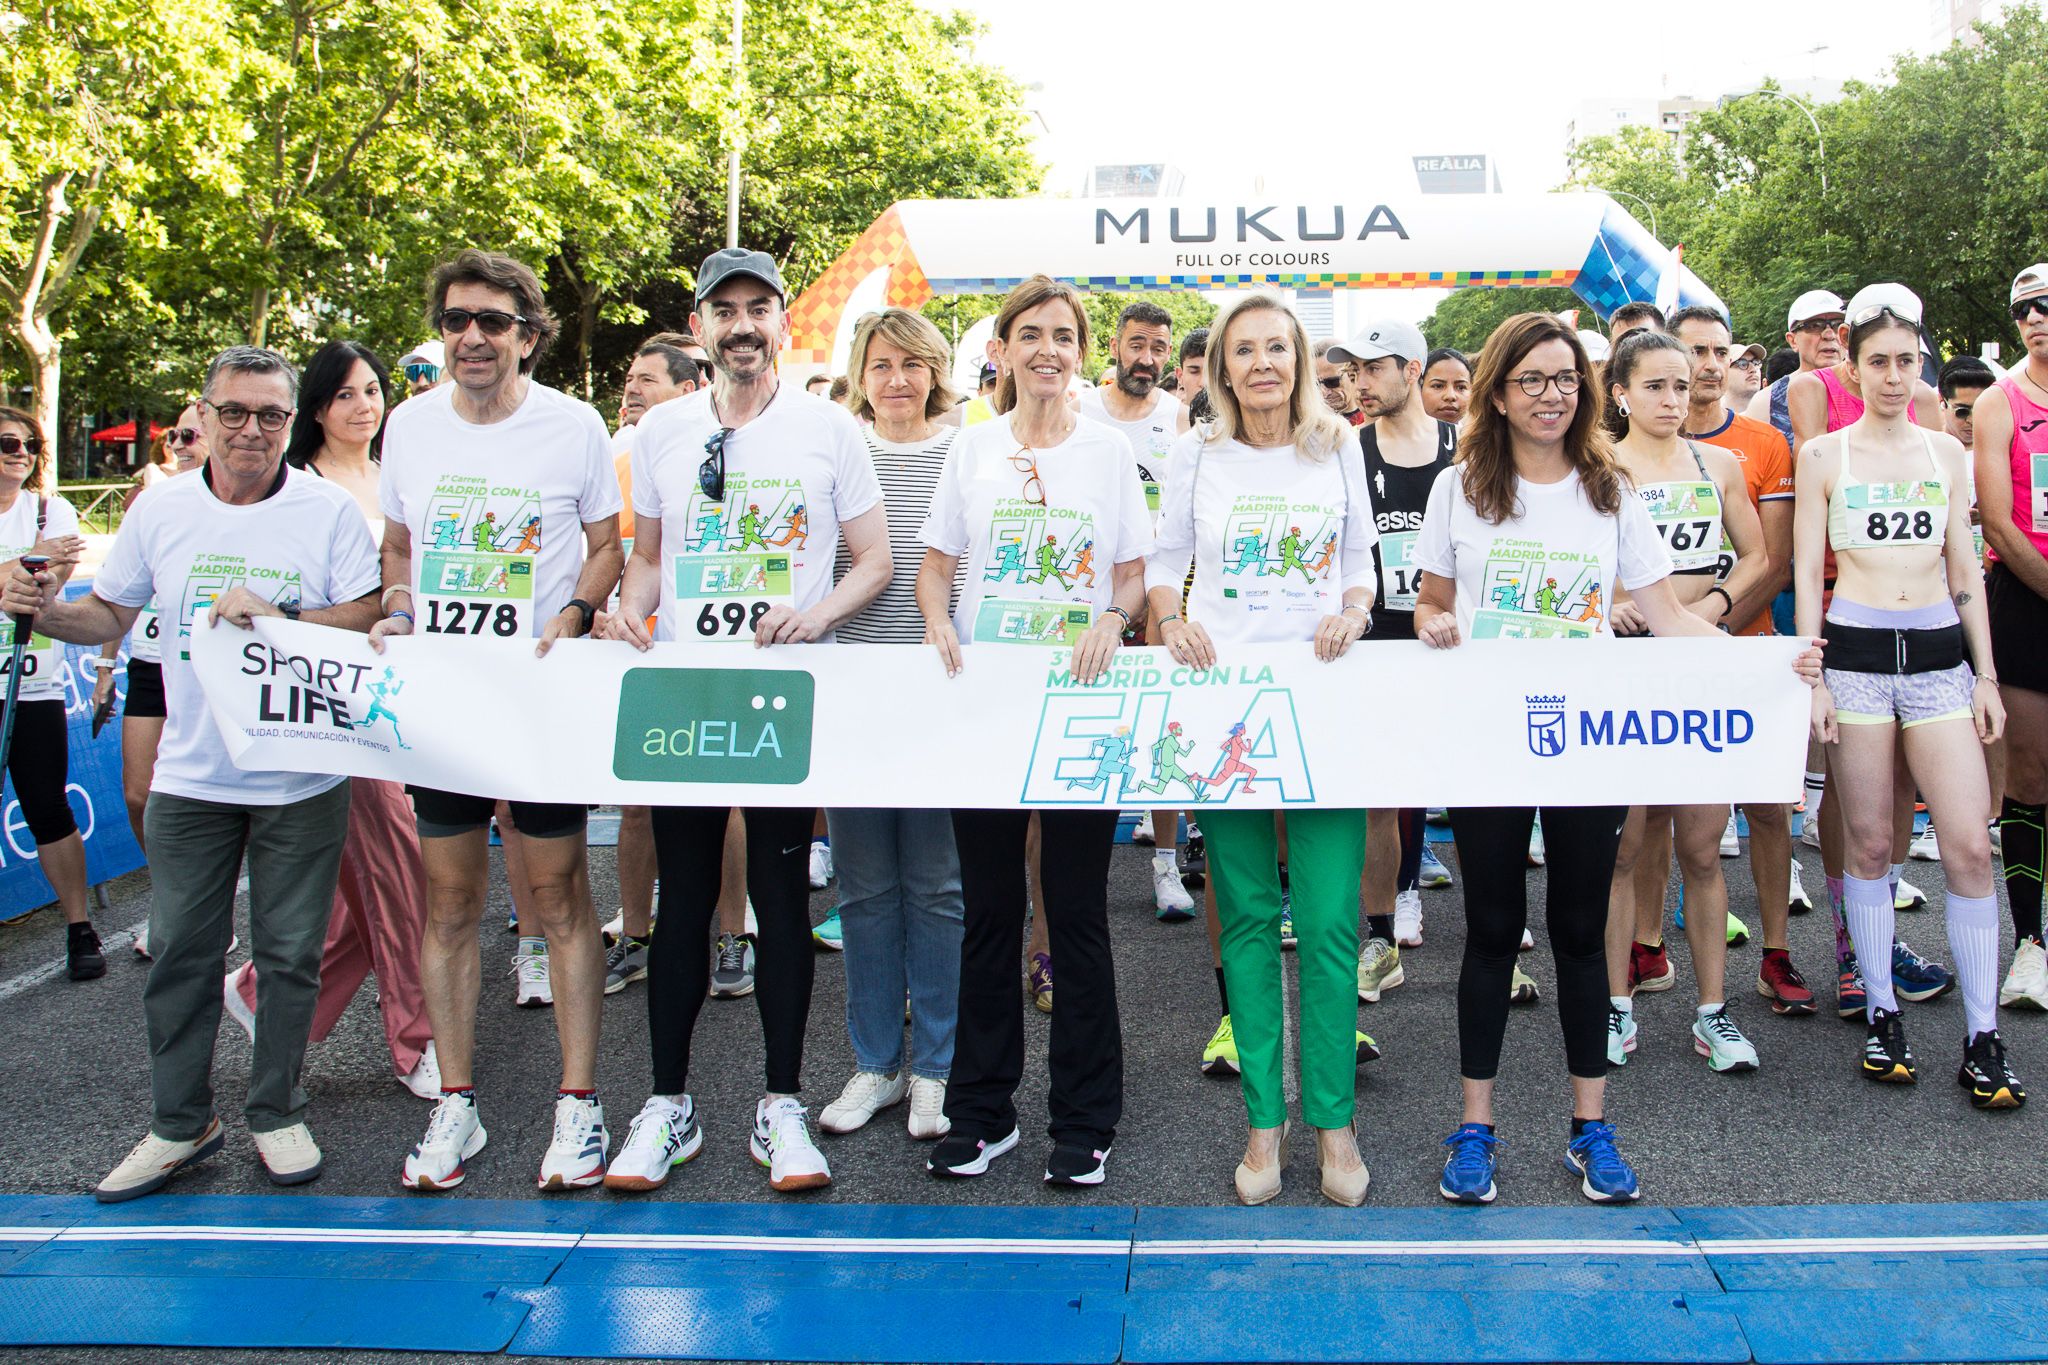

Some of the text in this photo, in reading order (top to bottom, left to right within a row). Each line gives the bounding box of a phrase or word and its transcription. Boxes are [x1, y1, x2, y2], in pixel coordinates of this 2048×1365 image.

[1095, 204, 1410, 244] MUKUA
[1176, 252, 1330, 267] FULL OF COLOURS
[450, 475, 487, 484] Carrera
[693, 479, 801, 491] MRID CON LA
[434, 485, 541, 499] MADRID CON LA
[1640, 488, 1665, 501] 384
[993, 508, 1094, 522] MADRID CON LA
[1232, 503, 1288, 513] MADRID
[1292, 503, 1320, 513] CON
[422, 494, 543, 548] ELA
[1376, 510, 1423, 532] asis
[1867, 510, 1933, 541] 828
[1506, 539, 1543, 548] Carrera
[207, 554, 246, 563] Carrera
[1489, 548, 1599, 563] MADRID CON LA
[191, 564, 301, 582] MADRID CON LA
[438, 562, 508, 593] ELA
[699, 563, 768, 593] ELA
[425, 600, 518, 637] 1278
[696, 601, 771, 637] 698
[997, 610, 1067, 642] ELA
[241, 642, 373, 694] SPORT
[1050, 650, 1072, 666] 3ª
[1170, 665, 1231, 687] CON
[1239, 665, 1275, 685] LA
[259, 684, 355, 730] LIFE
[283, 728, 350, 743] COMUNICACIÓN
[357, 737, 391, 753] EVENTOS
[642, 720, 783, 758] adELA
[1580, 709, 1754, 753] MADRID
[1020, 688, 1316, 804] ELA
